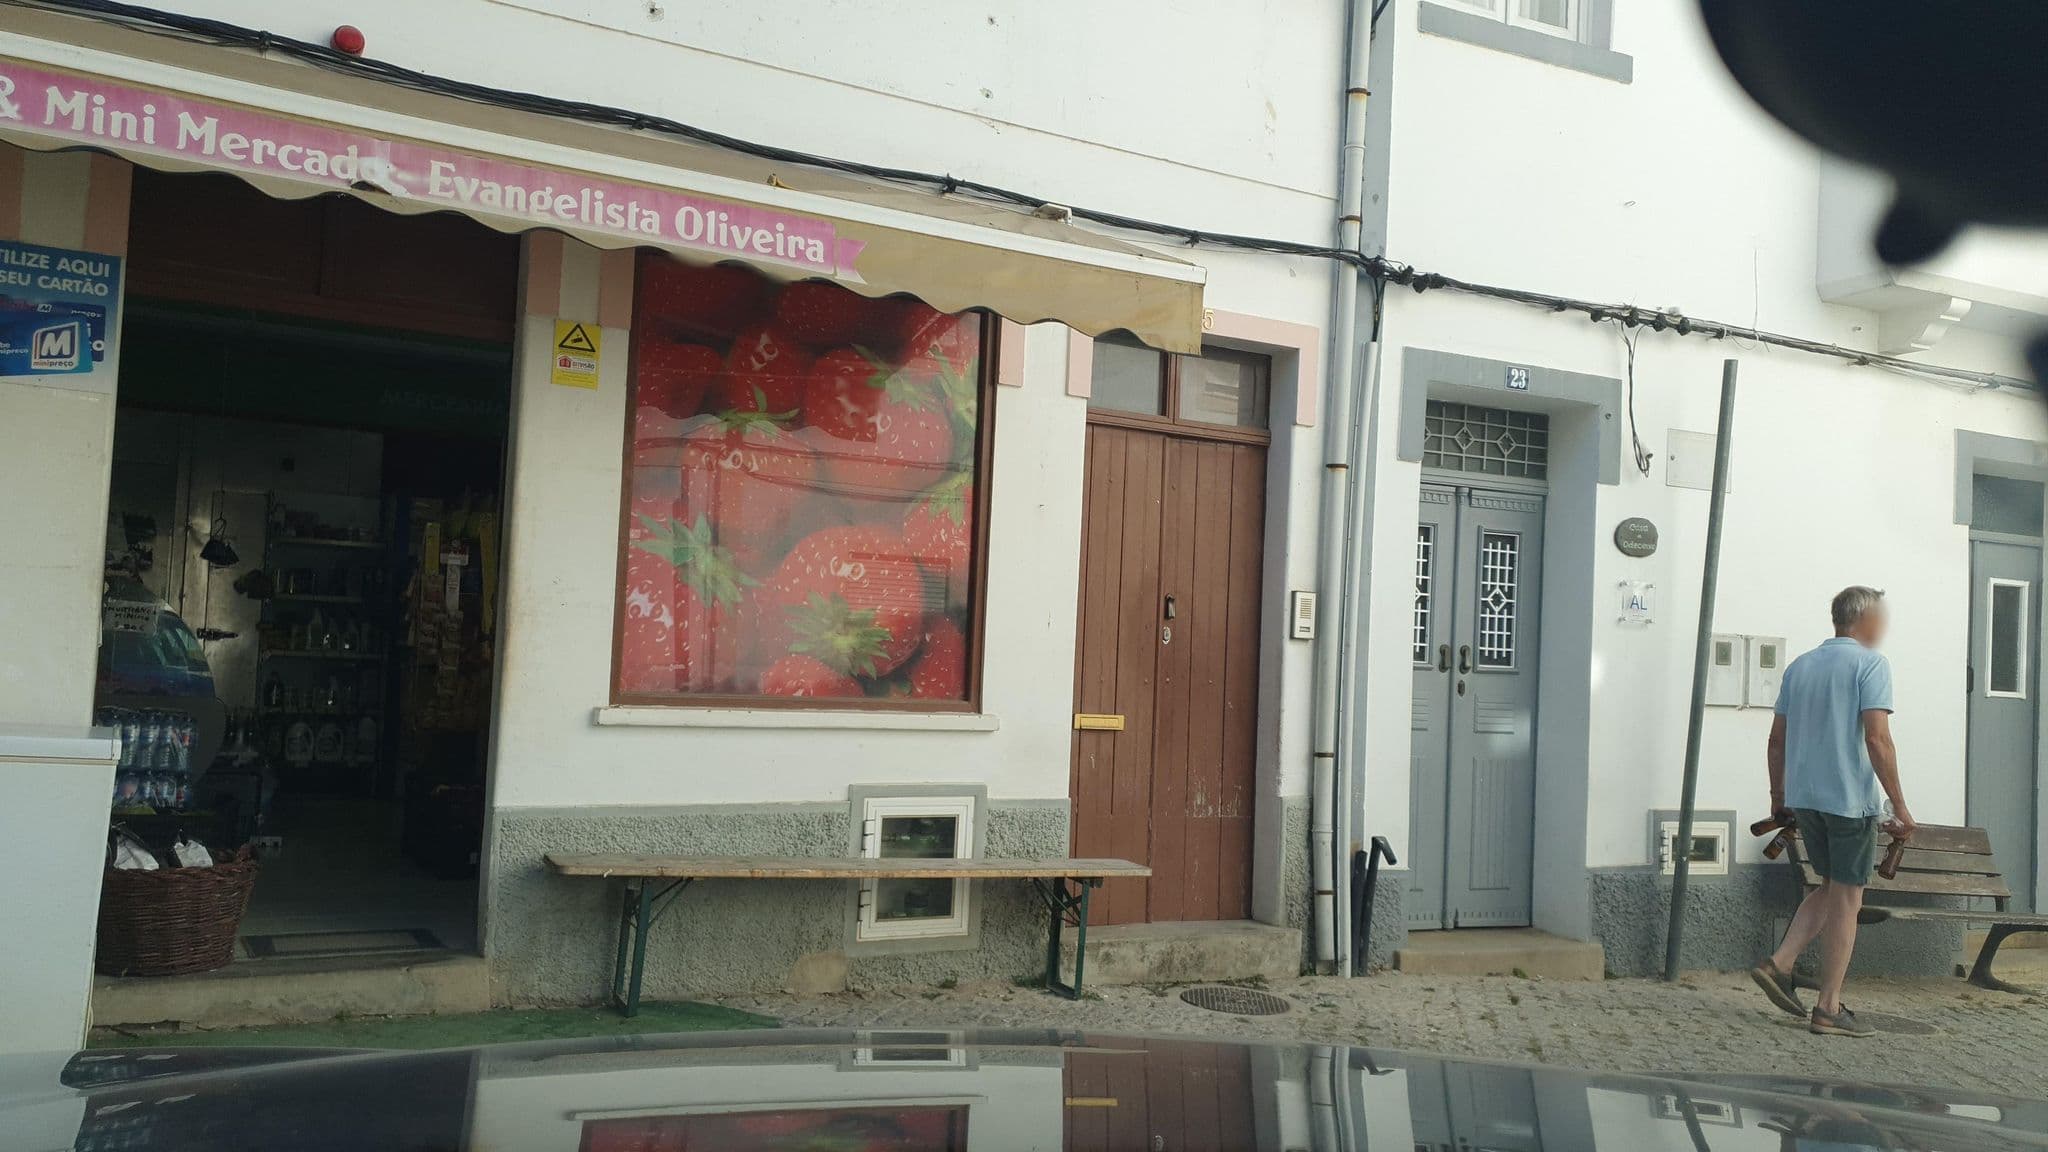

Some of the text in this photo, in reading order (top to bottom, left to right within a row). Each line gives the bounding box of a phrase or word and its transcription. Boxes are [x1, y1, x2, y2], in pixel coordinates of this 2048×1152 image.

[0, 75, 23, 120] &
[43, 86, 156, 145] Mini
[429, 160, 661, 236] Evangelista
[675, 206, 825, 263] Oliveira
[56, 257, 111, 278] AQUI
[37, 274, 109, 297] CARTÃO
[33, 360, 74, 368] minipreço
[1510, 368, 1526, 389] 23
[1629, 594, 1648, 611] AL
